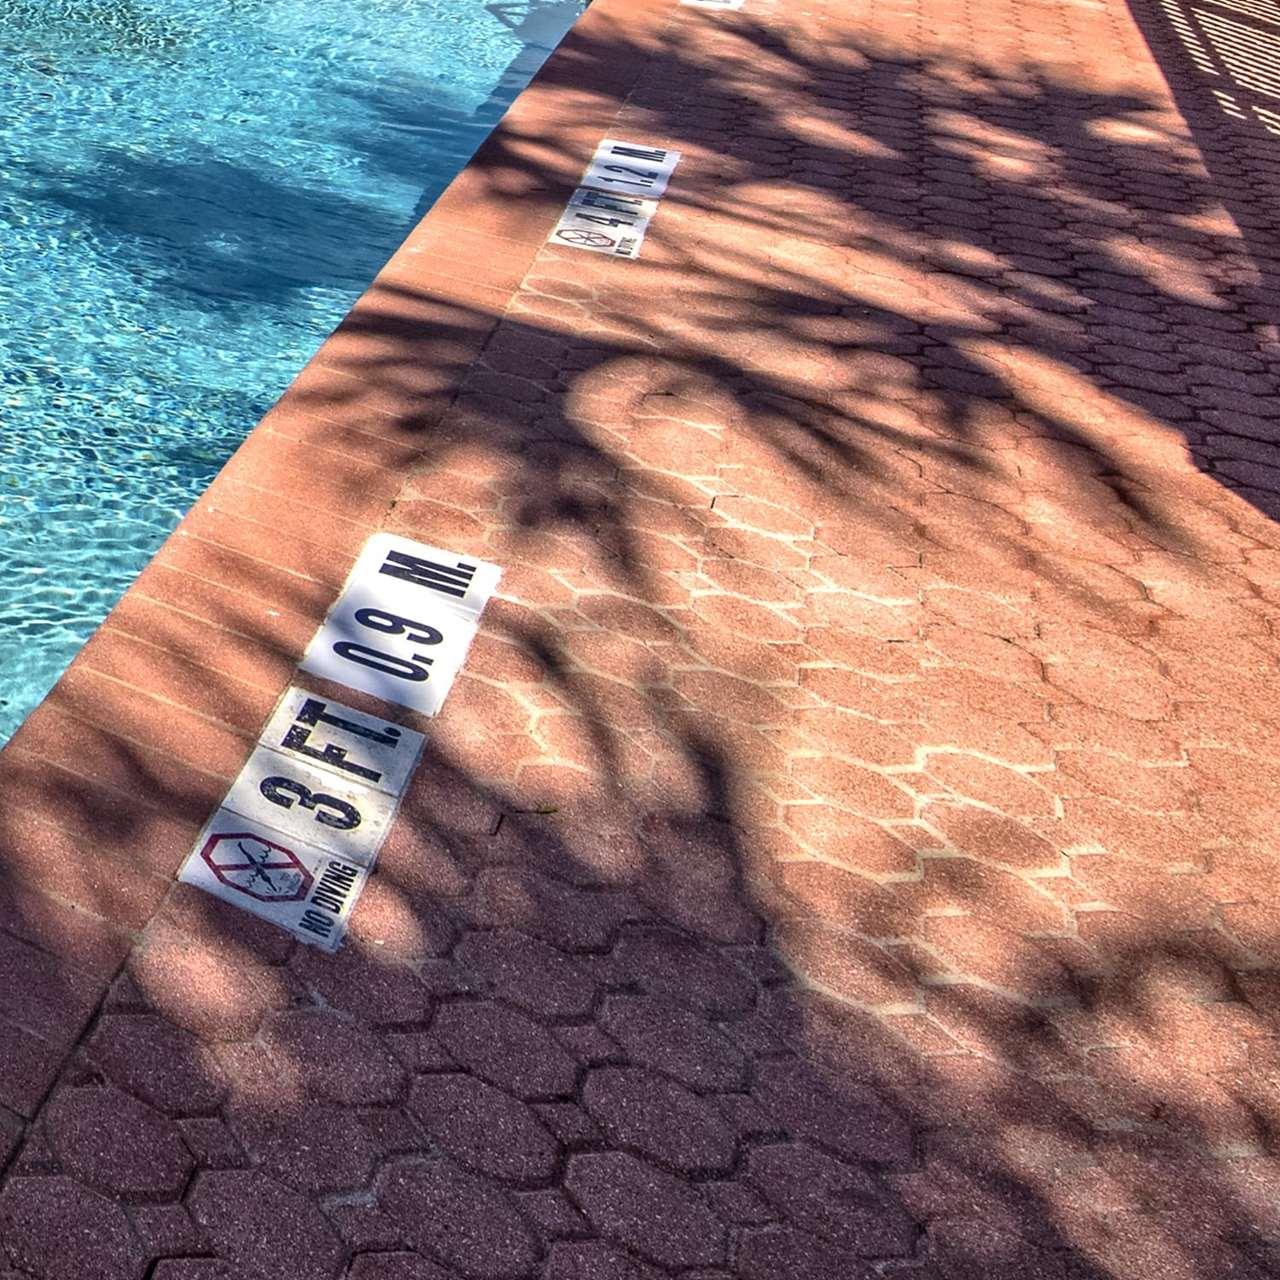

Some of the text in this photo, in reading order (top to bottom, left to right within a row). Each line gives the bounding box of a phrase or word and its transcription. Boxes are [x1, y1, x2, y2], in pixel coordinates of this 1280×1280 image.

[259, 549, 477, 832] 3 FT. 0.9 M.
[298, 860, 358, 938] NO DIVING
